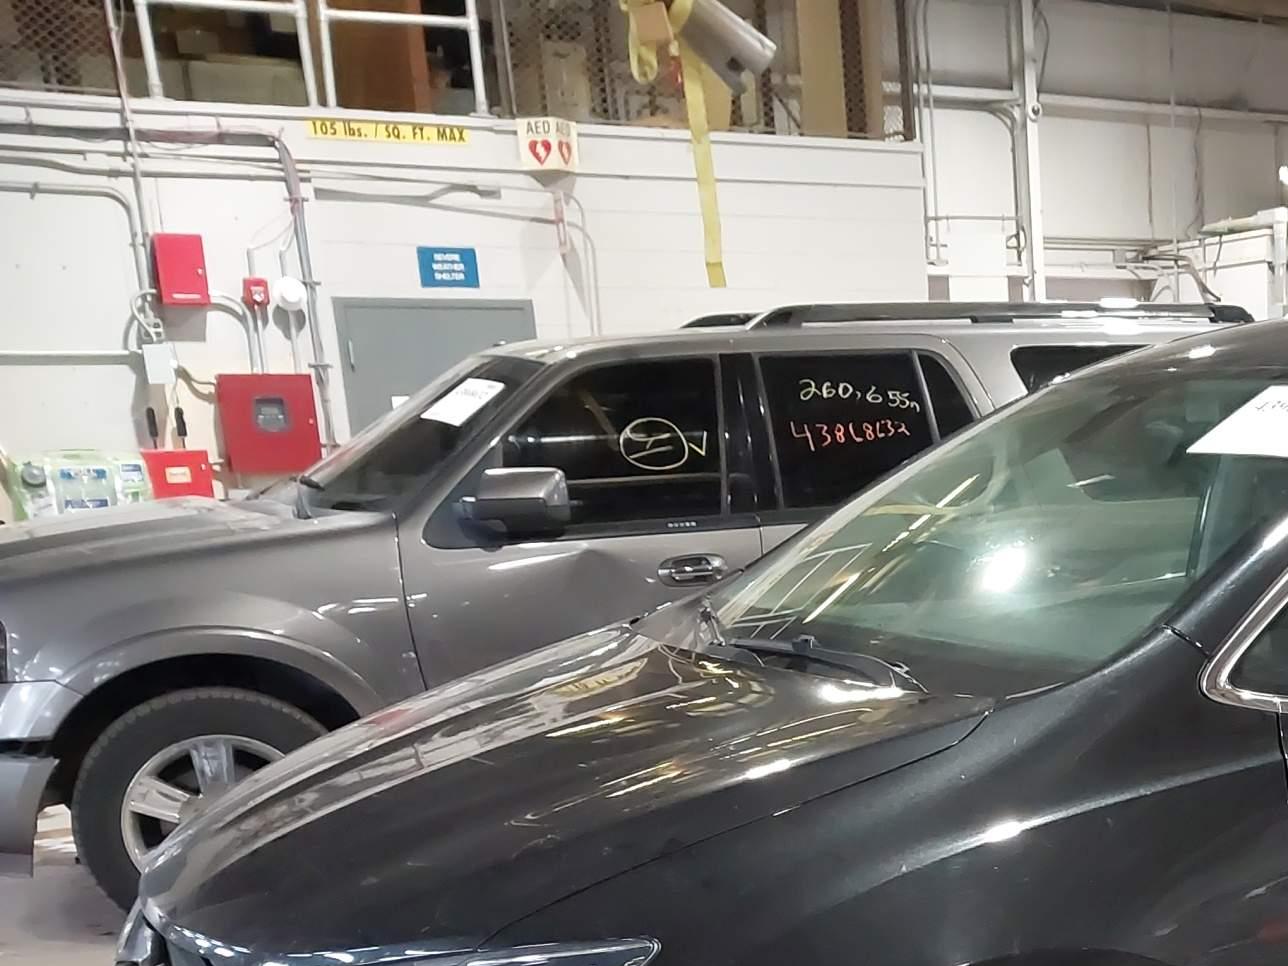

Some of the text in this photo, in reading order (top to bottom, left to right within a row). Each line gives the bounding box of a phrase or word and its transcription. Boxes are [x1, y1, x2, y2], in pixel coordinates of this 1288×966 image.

[312, 121, 337, 136] 105
[343, 121, 368, 138] lbs.
[385, 124, 406, 140] SQ.
[411, 126, 431, 141] FT.
[436, 127, 466, 142] MAX
[526, 120, 551, 134] AED
